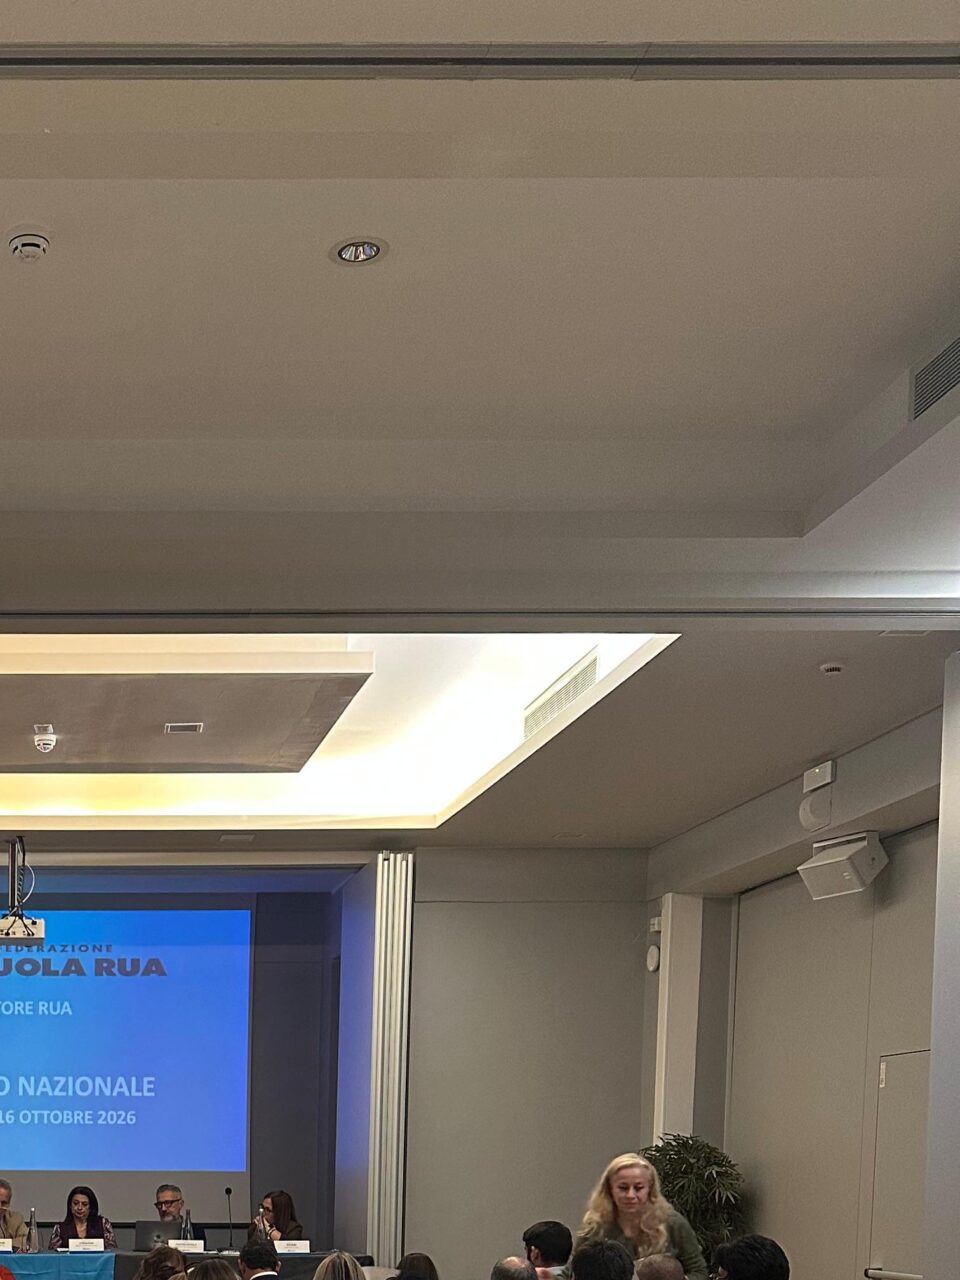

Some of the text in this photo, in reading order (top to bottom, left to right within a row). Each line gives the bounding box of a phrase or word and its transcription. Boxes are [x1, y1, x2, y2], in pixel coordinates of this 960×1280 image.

[94, 957, 168, 976] RUA
[38, 1000, 72, 1015] RUA
[18, 1076, 155, 1097] NAZIONALE
[19, 1109, 93, 1125] OTTOBRE
[97, 1110, 136, 1125] 2026
